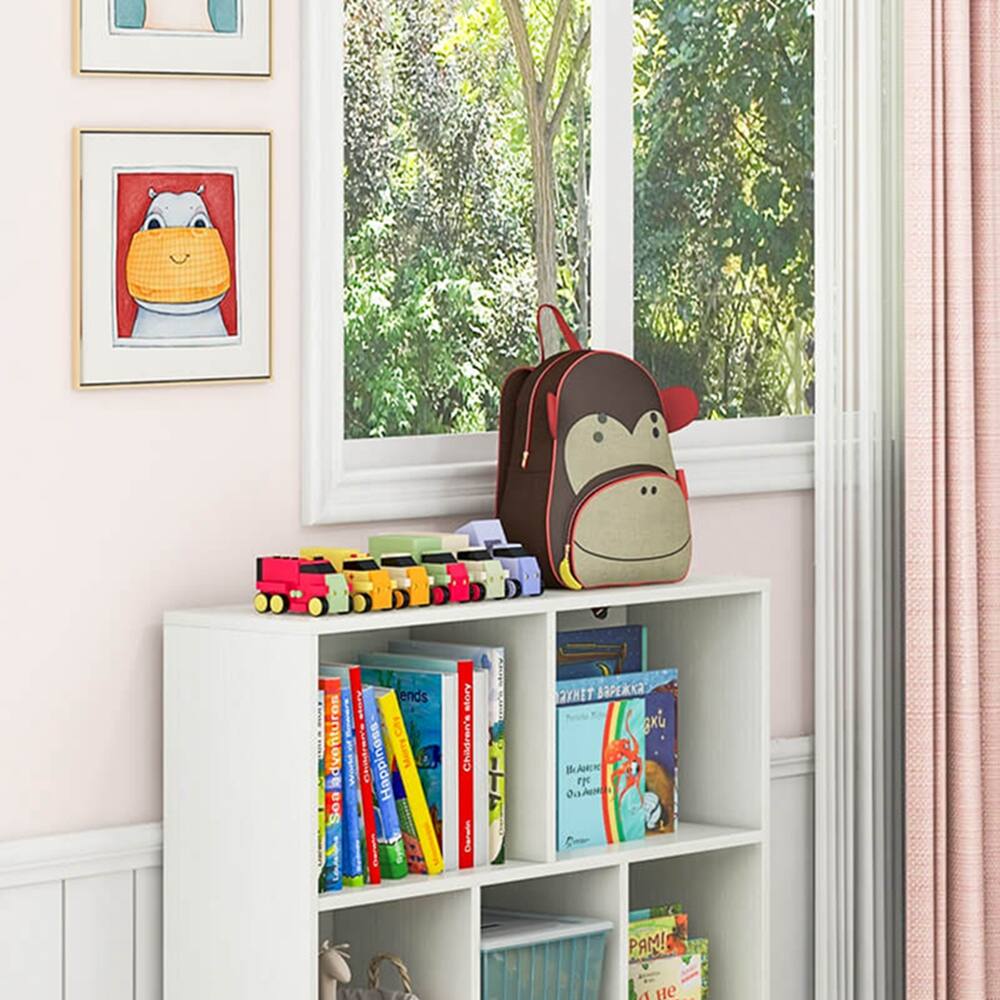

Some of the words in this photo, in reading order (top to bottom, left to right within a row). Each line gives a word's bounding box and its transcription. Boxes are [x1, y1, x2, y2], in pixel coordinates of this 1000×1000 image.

[356, 689, 365, 720] story
[464, 682, 473, 712] story
[329, 694, 341, 789] adventures
[359, 723, 371, 784] Children's
[369, 720, 393, 801] Happiness
[464, 714, 472, 772] Children's
[329, 791, 341, 824] Sea
[464, 820, 472, 853] Darwin
